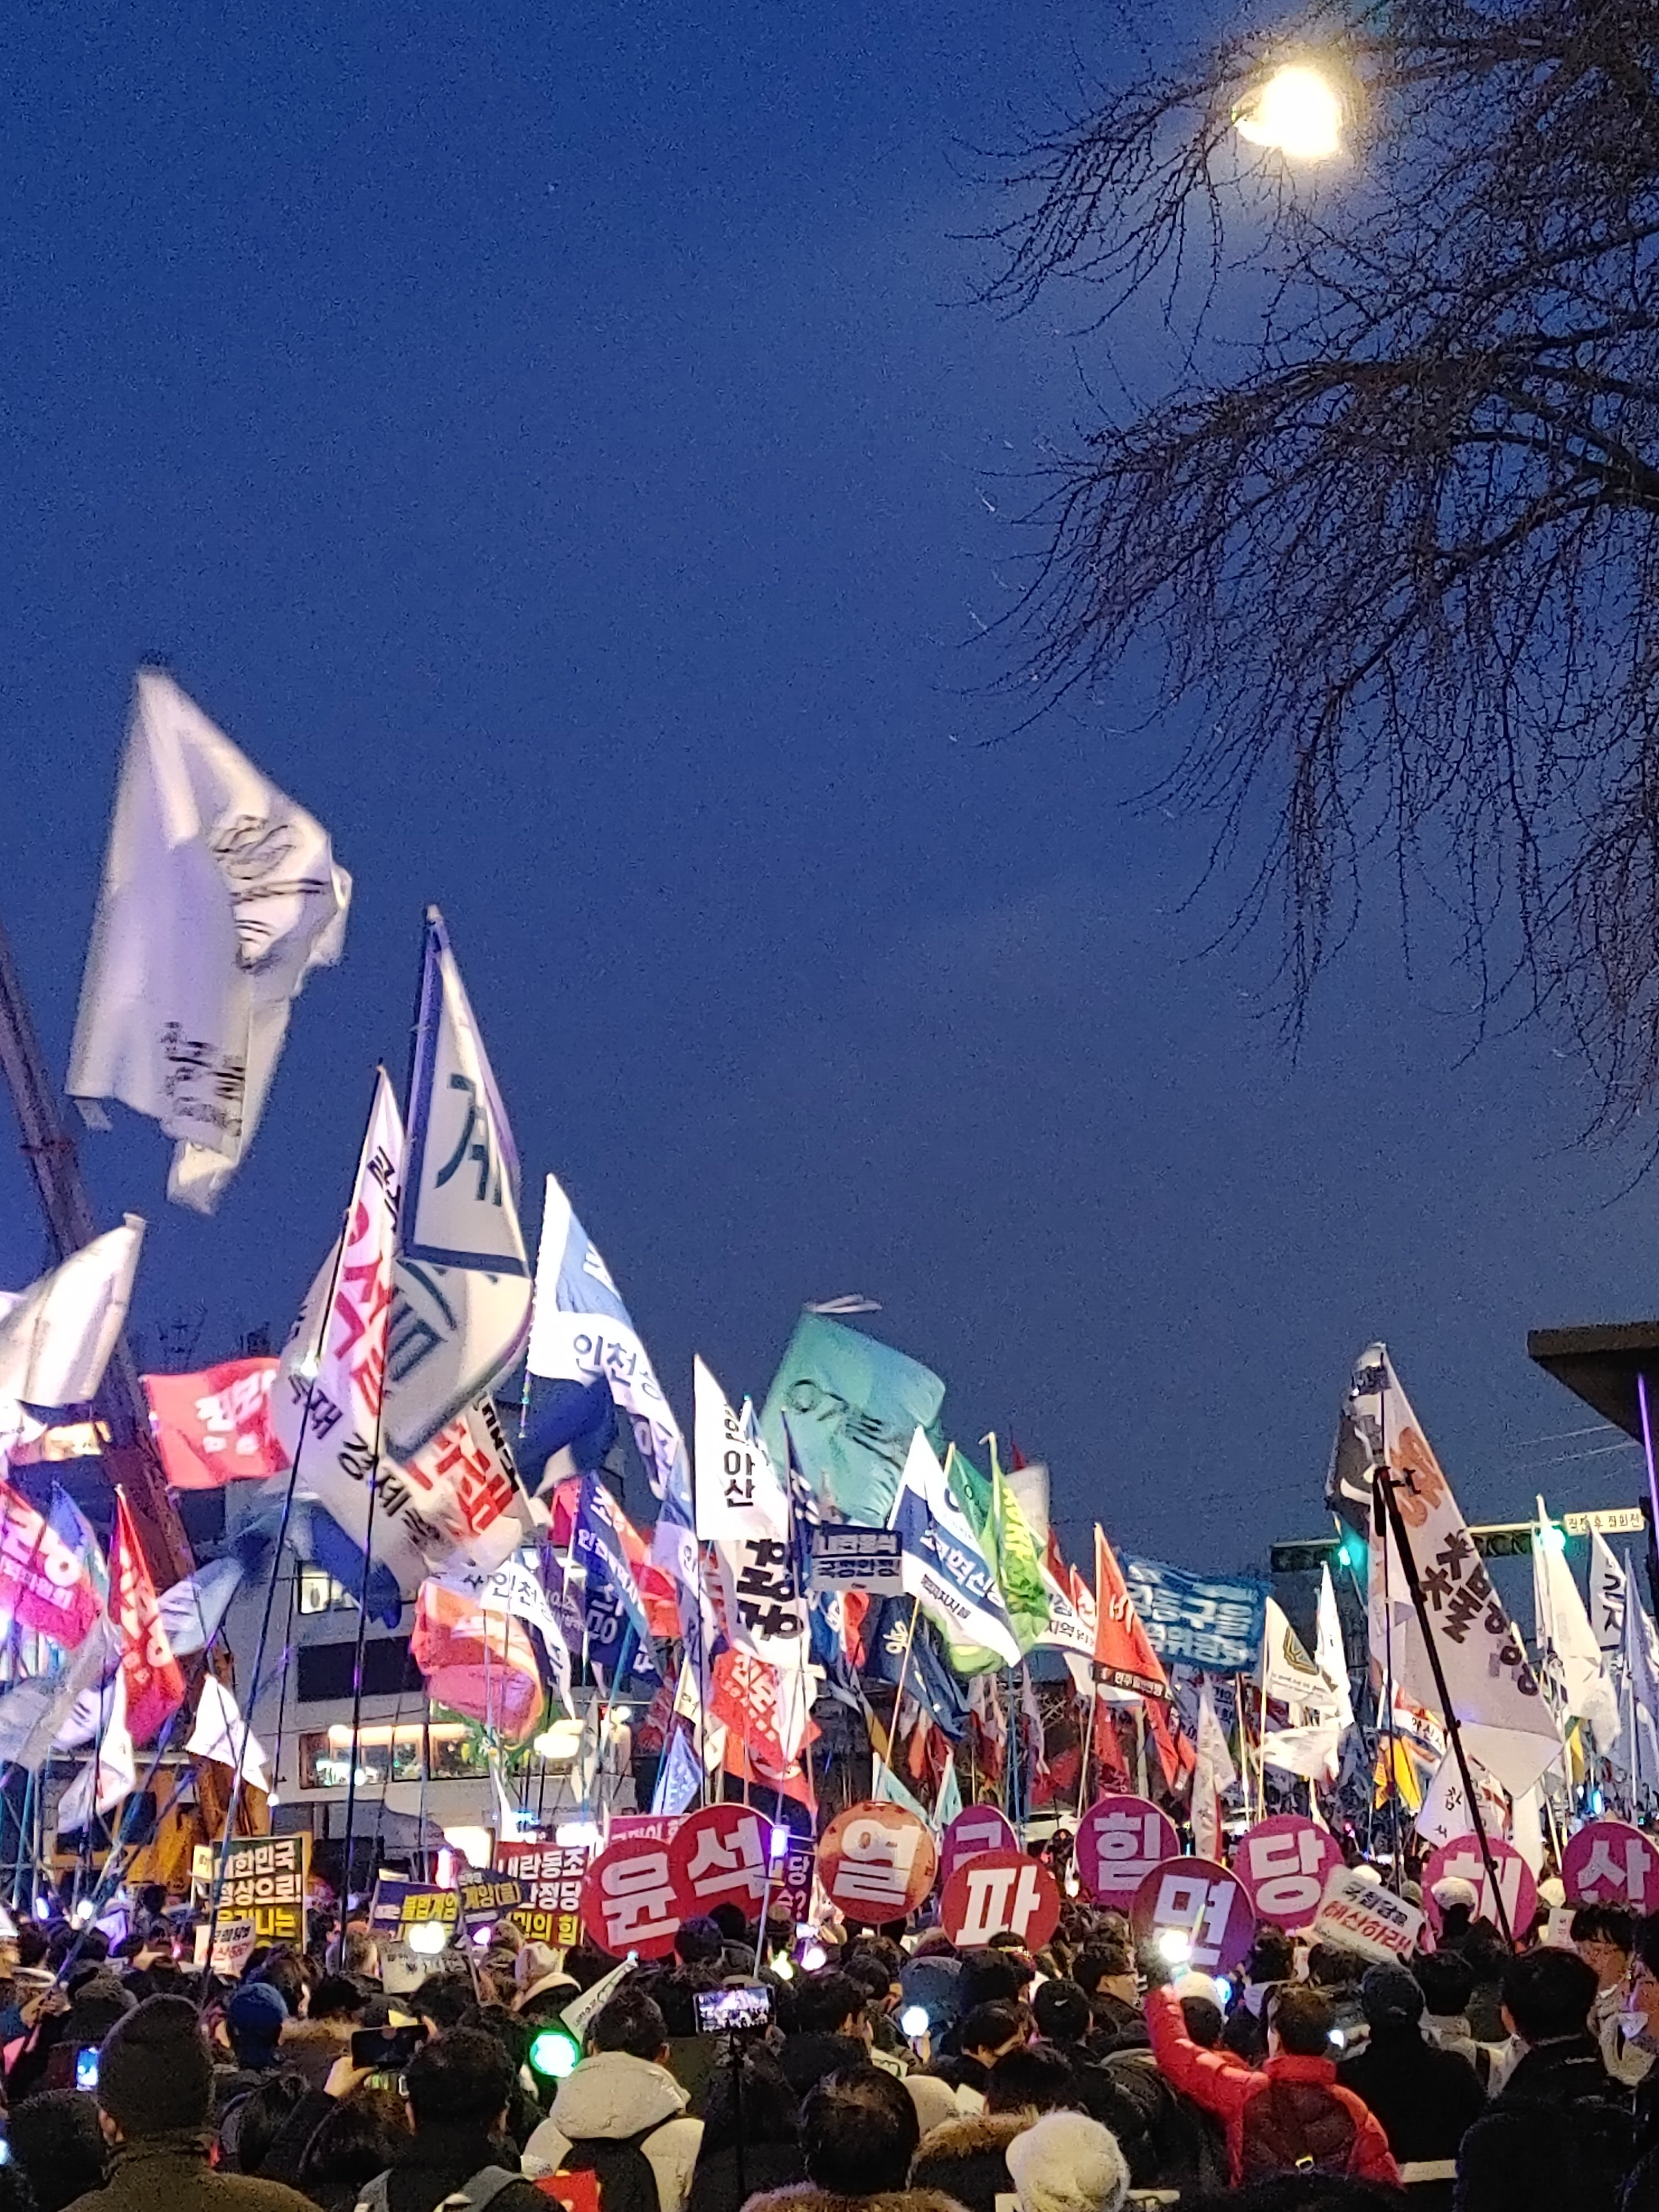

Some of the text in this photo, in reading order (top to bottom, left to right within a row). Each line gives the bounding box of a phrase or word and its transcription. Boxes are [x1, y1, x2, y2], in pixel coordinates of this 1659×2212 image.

[687, 1815, 769, 1901] 석
[1093, 1812, 1161, 1891] 힘
[1248, 1828, 1326, 1915] 당
[558, 1914, 578, 1946] 힘
[601, 1853, 681, 1948] 윤
[955, 1865, 1040, 1948] 파
[1152, 1874, 1237, 1966] 면
